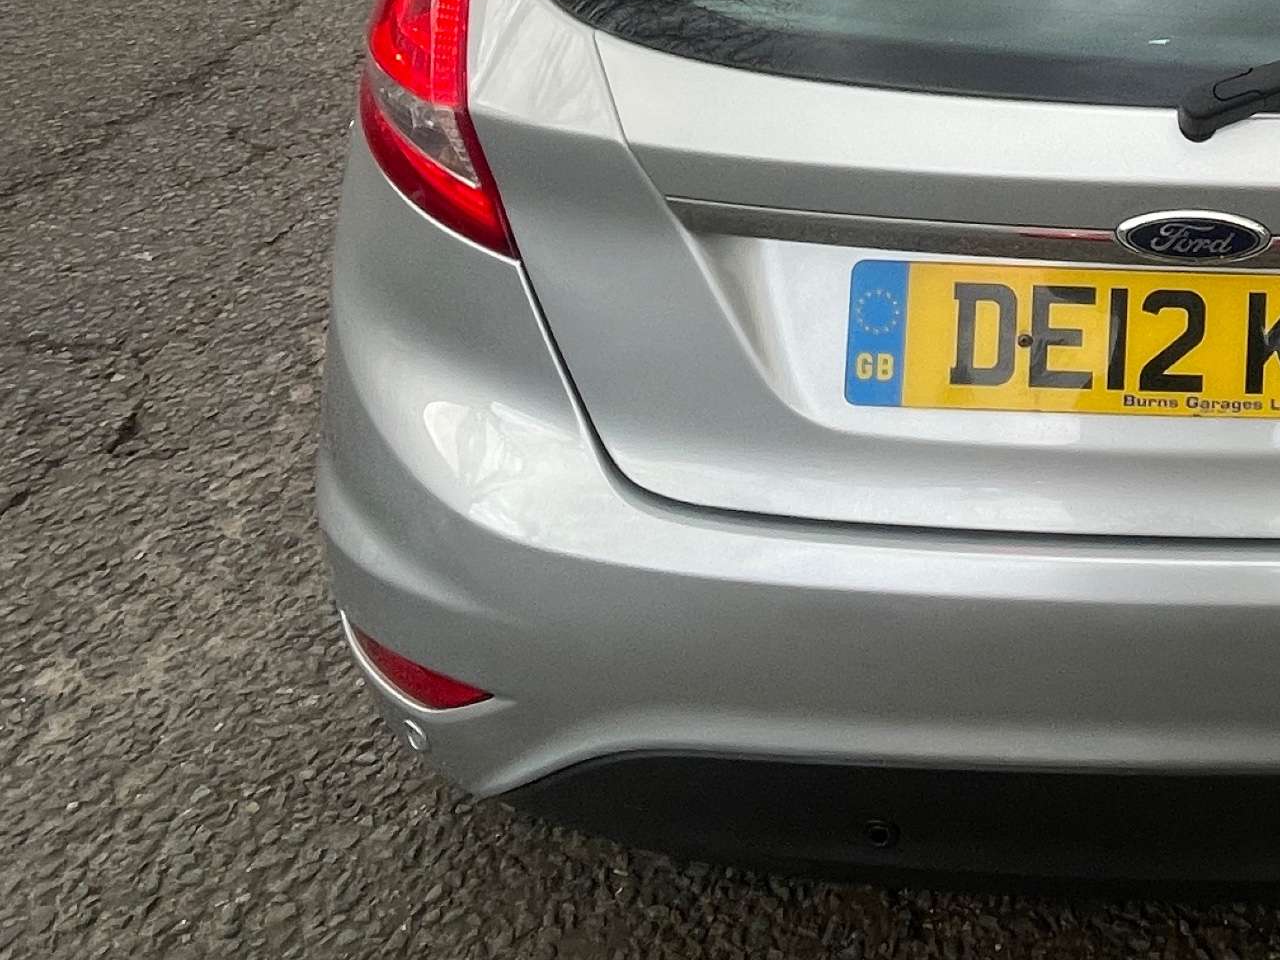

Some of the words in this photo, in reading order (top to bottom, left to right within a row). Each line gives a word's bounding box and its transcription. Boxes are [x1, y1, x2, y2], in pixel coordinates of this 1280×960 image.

[1150, 221, 1233, 255] Ford
[949, 282, 1206, 393] DE12
[855, 352, 895, 381] GB
[1123, 394, 1179, 409] Burns
[1185, 396, 1263, 413] Garages
